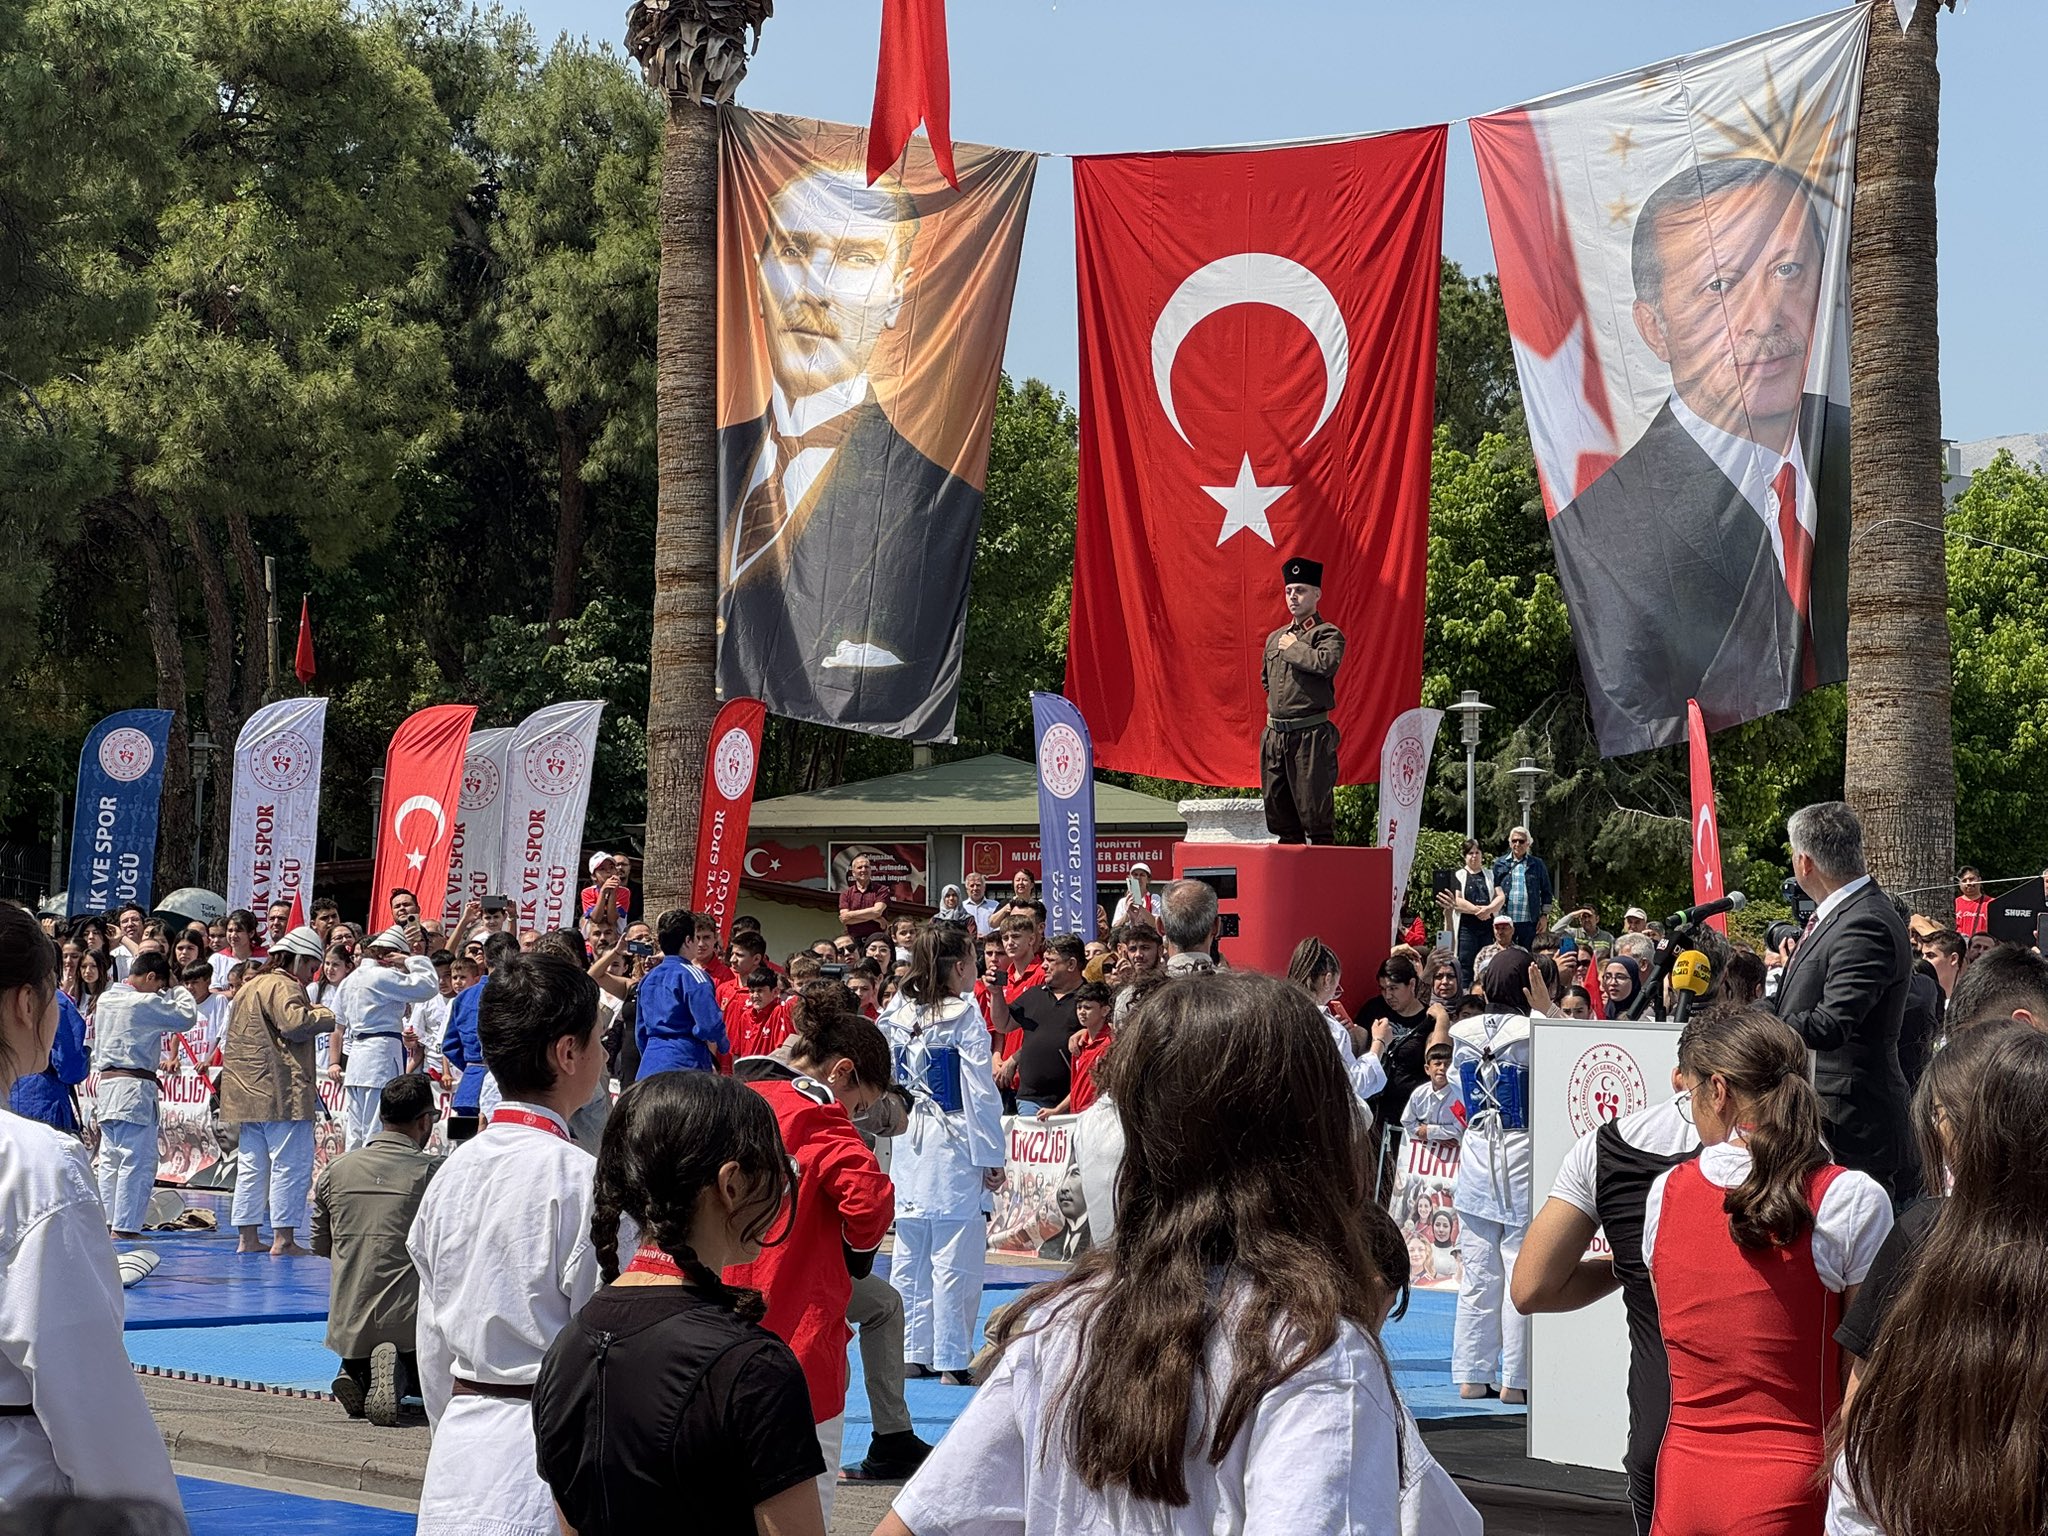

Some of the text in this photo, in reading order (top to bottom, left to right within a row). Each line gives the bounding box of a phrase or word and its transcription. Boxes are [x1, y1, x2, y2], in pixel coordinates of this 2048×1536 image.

[254, 804, 274, 856] SPOR
[525, 809, 546, 863] SPOR
[709, 809, 726, 865] SPOR
[86, 797, 117, 912] İK VE SPOR
[450, 822, 466, 869] SPOR
[1011, 849, 1163, 861] MUHA ER DERNEĞİ
[1095, 840, 1141, 849] HURİYETİ
[115, 853, 140, 902] ÜĞÜ
[253, 860, 271, 886] VE
[522, 867, 540, 893] VE
[1097, 861, 1130, 873] UBESİ
[447, 872, 462, 895] VE
[706, 869, 718, 897] VE
[713, 869, 730, 931] LÜĞÜ
[2004, 908, 2033, 918] SHURE
[1620, 1074, 1628, 1083] VE
[1625, 1083, 1633, 1103] SPOR
